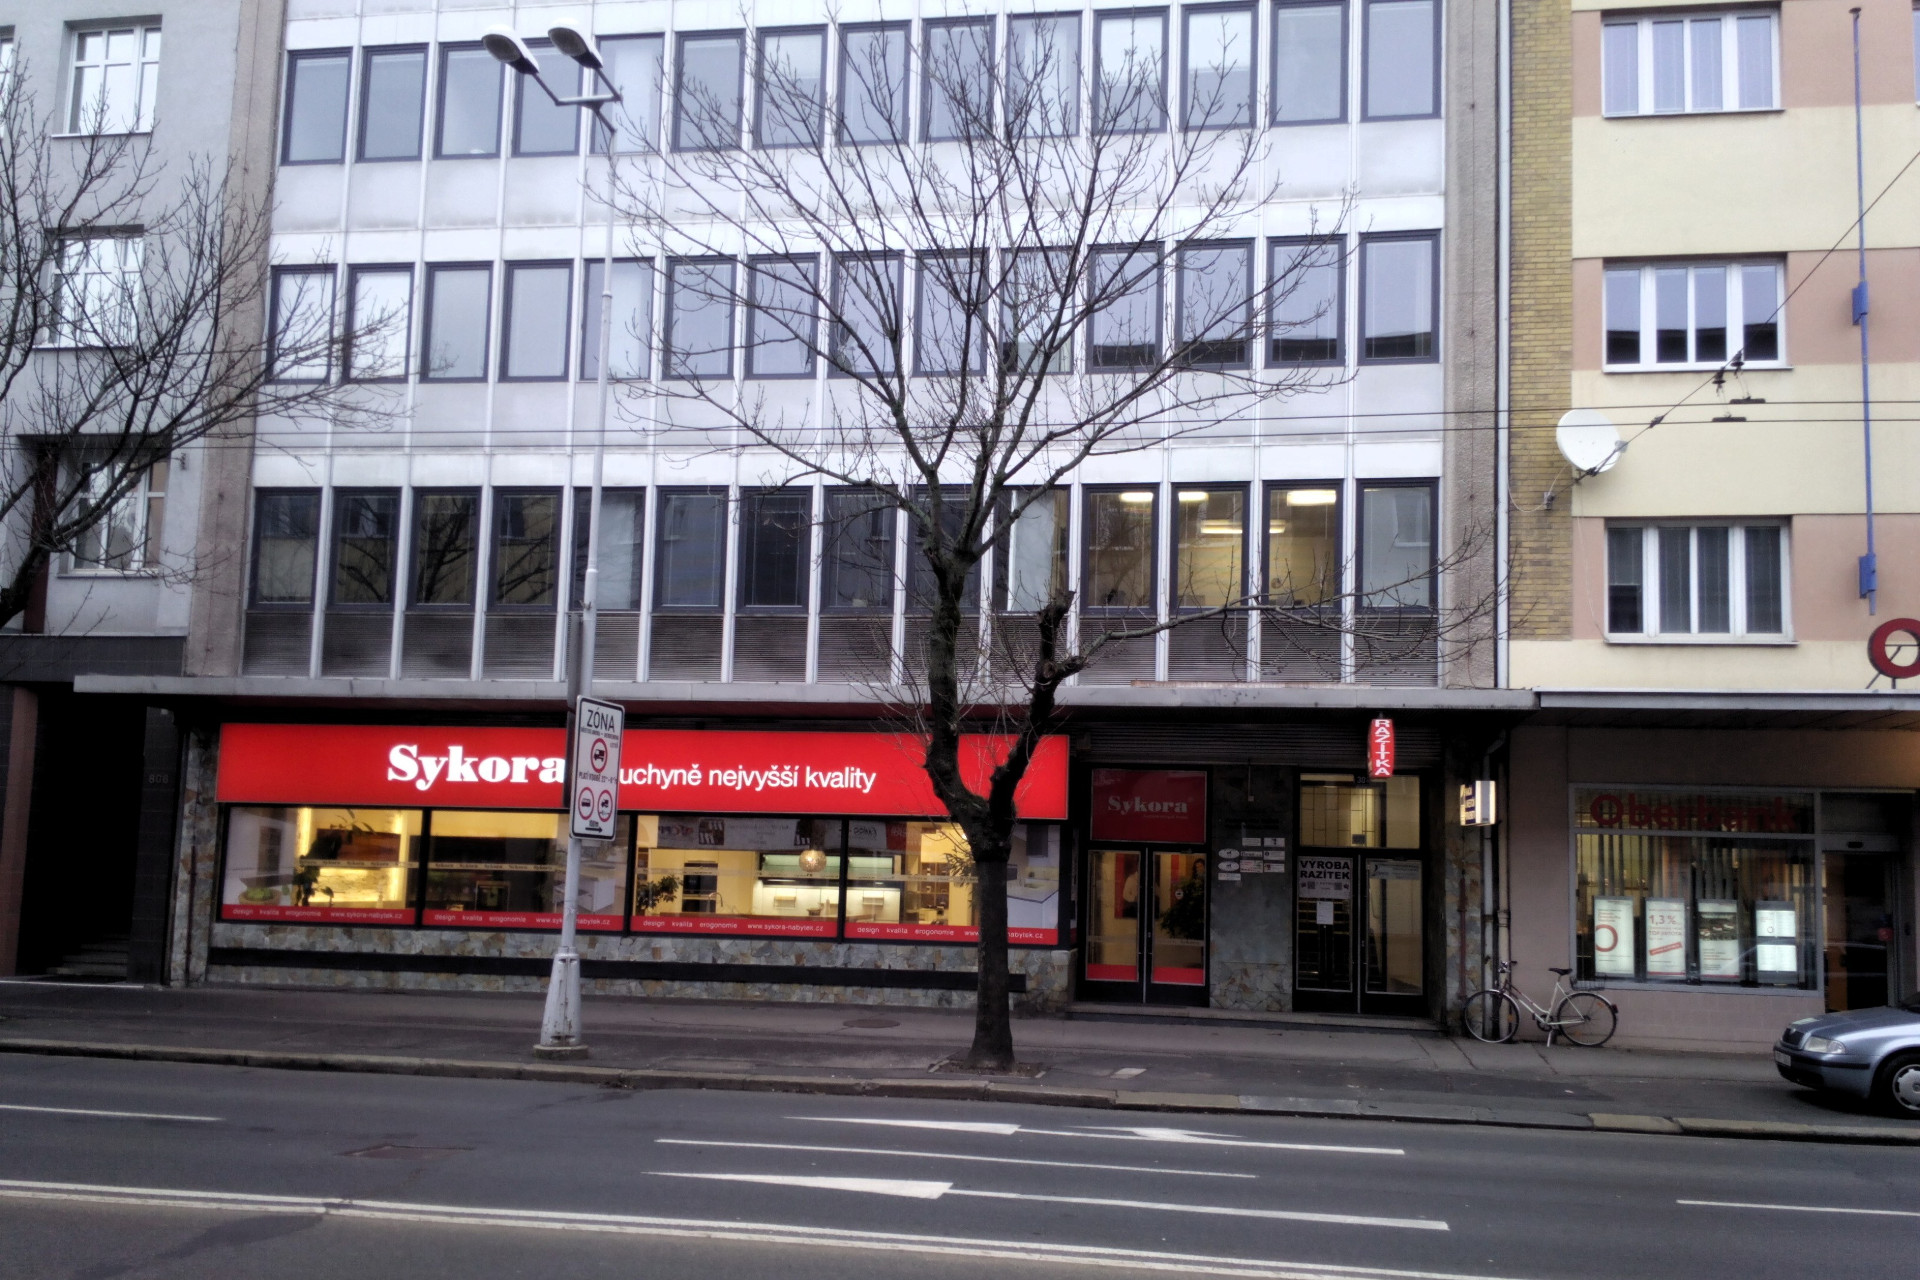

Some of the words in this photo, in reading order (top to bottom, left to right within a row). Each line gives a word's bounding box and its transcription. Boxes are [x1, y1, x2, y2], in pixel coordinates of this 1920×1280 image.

[587, 707, 615, 732] ZÓNA
[387, 744, 566, 791] Sykora
[619, 764, 702, 790] uchyně
[709, 765, 799, 791] nejvyšší
[805, 766, 876, 793] kvality
[1108, 796, 1187, 815] Sykora
[1590, 793, 1797, 830] Oberbank
[1300, 859, 1350, 870] VÝROBA
[1300, 869, 1350, 880] RAZÍTEK
[233, 909, 253, 917] design
[435, 913, 456, 922] design
[643, 919, 665, 928] design
[748, 923, 824, 932] www.sykora-nabytek.cz
[857, 926, 880, 934] design
[887, 926, 908, 934] kvalita
